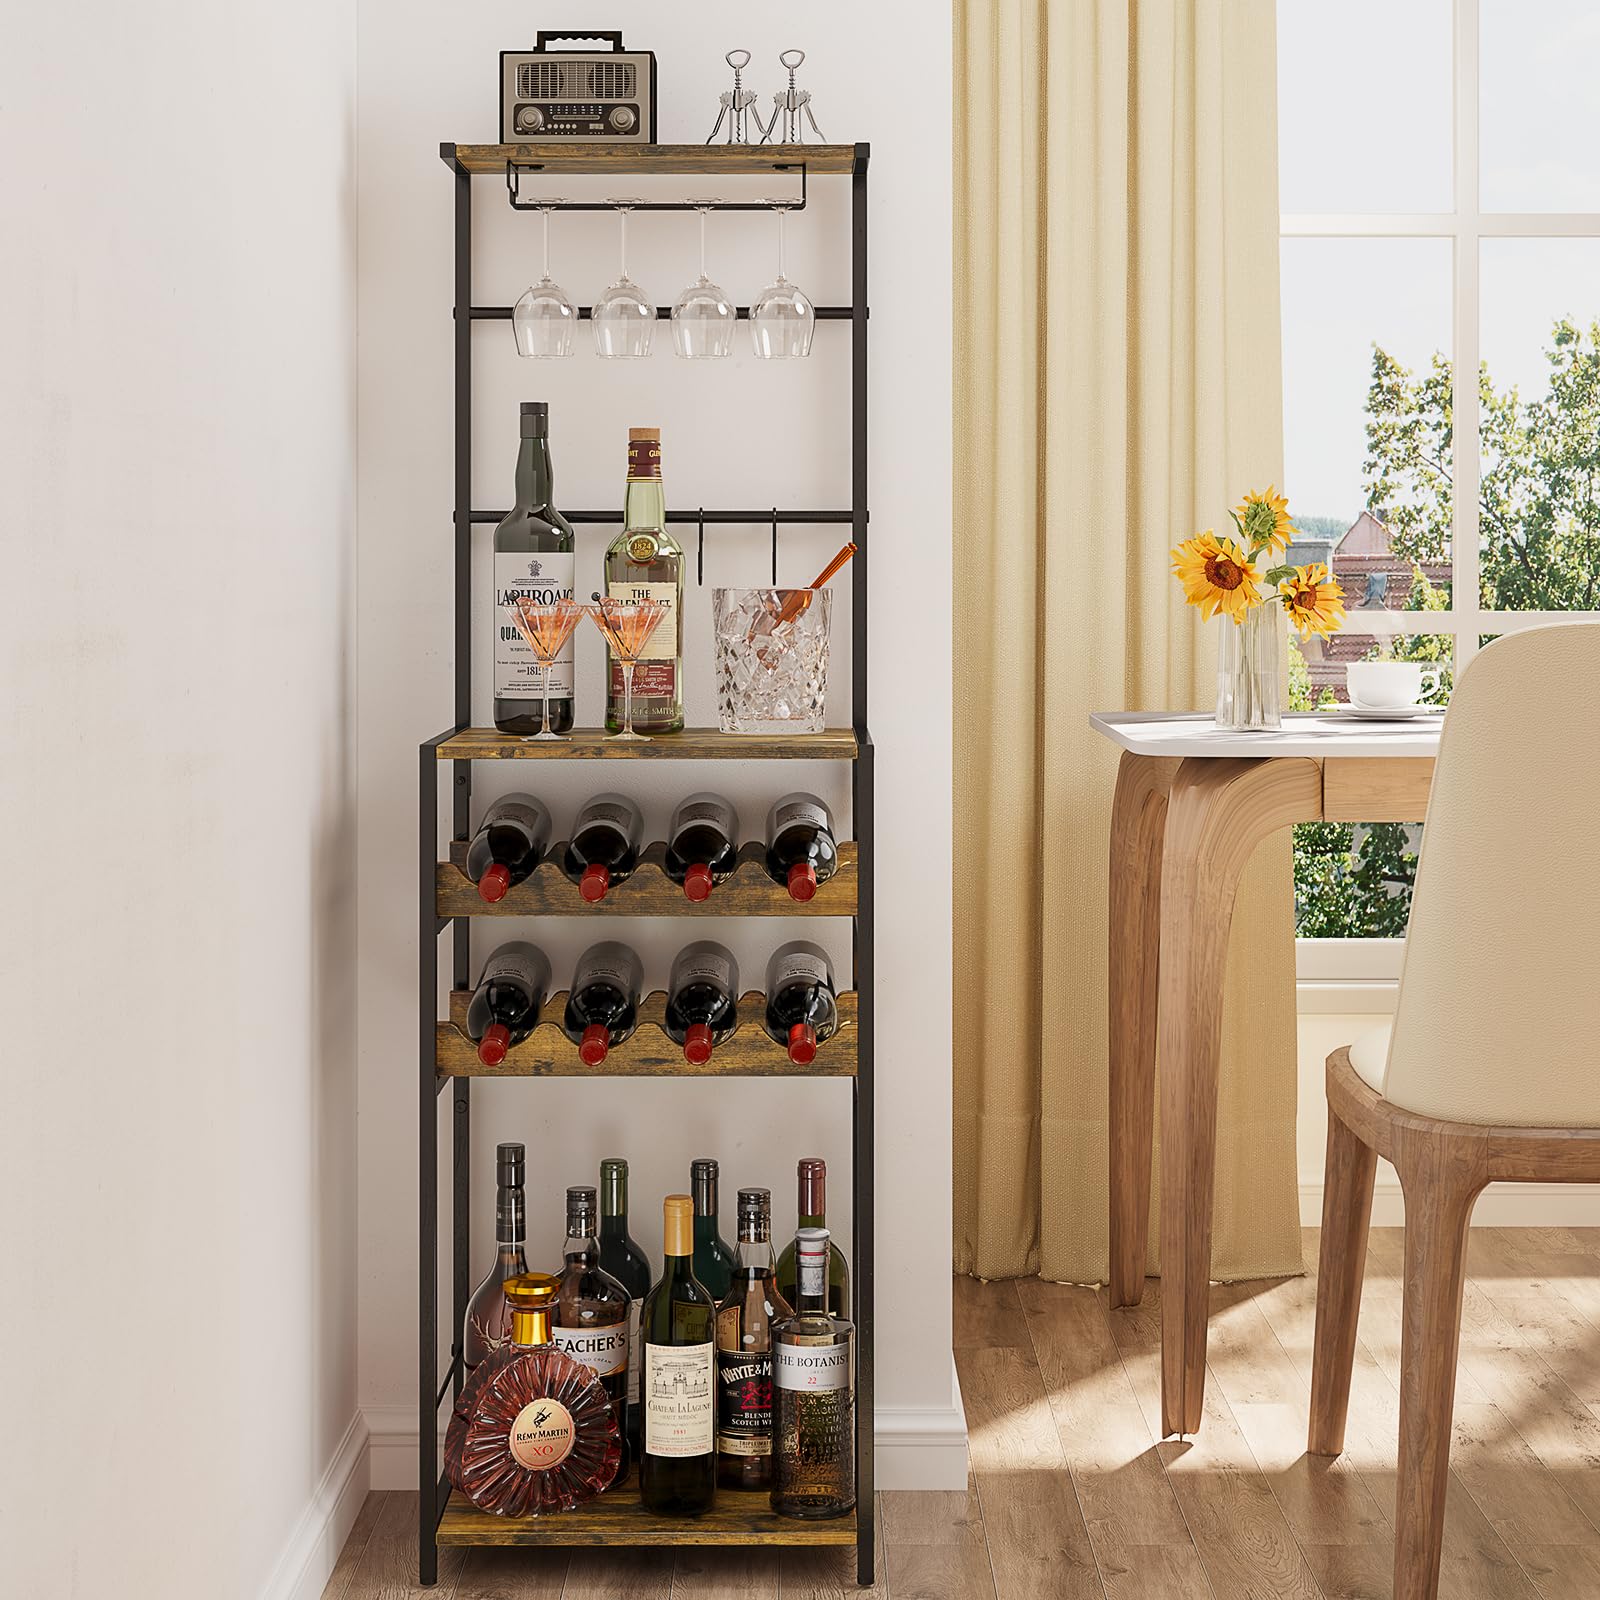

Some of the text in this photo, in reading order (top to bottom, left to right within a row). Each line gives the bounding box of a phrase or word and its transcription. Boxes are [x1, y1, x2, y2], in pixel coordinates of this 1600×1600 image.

[631, 589, 651, 599] THE
[554, 1332, 626, 1353] EACHER'S
[776, 1353, 795, 1366] THE
[807, 1376, 818, 1385] 22
[731, 1418, 760, 1426] SCOTCH
[538, 1428, 569, 1438] MARTIN
[532, 1445, 554, 1457] XO
